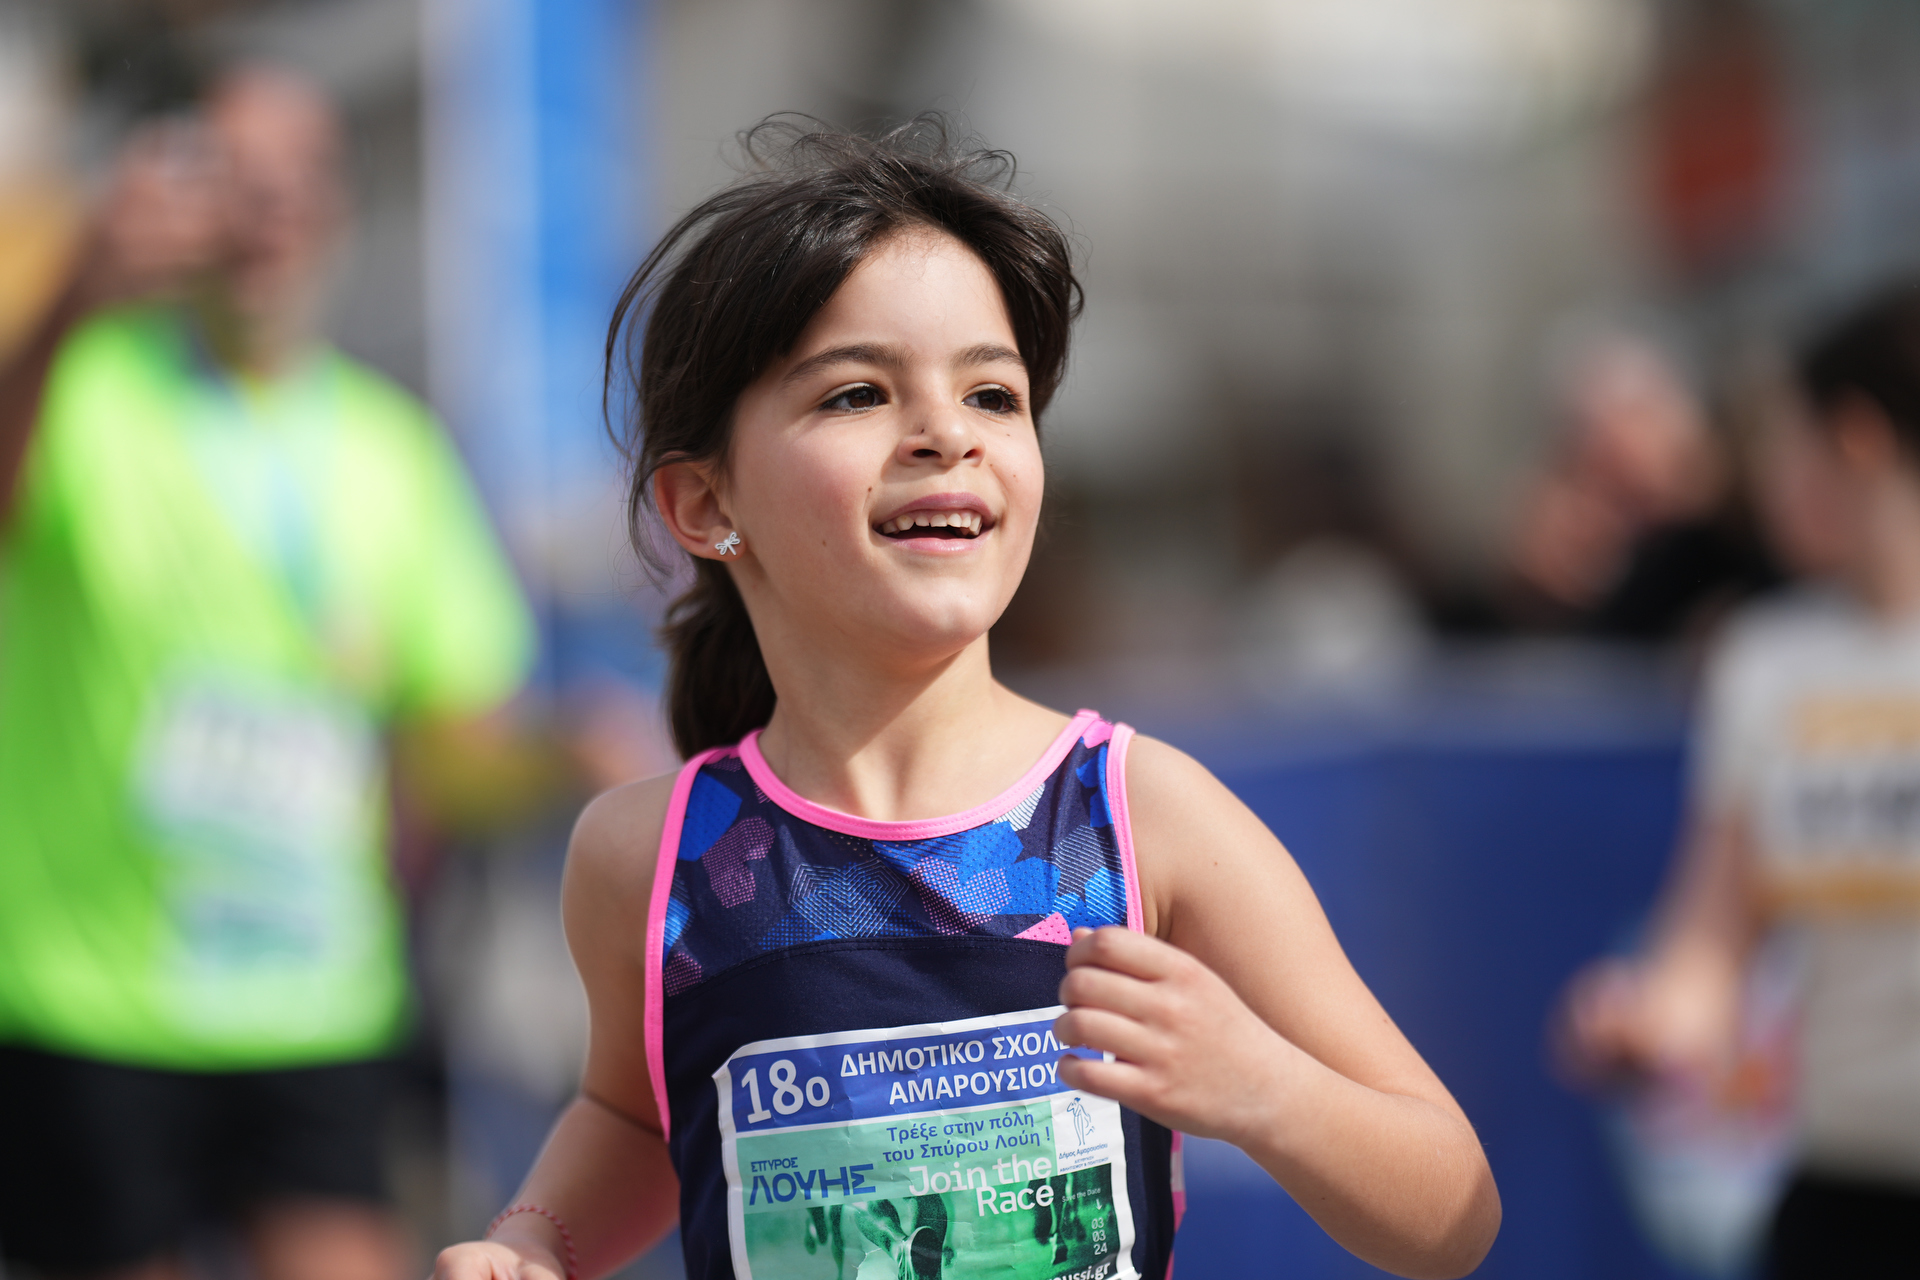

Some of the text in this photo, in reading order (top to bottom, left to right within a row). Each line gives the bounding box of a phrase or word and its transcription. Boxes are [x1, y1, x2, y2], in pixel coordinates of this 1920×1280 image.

[840, 1040, 985, 1077] ΔΗΜΟΤΙΚΟ
[992, 1029, 1070, 1060] ΣΧΟΛ
[889, 1061, 1059, 1105] ΑΜΑΡΟΥΣΙΟΥ
[886, 1111, 1035, 1144] Τρέξε στην πόλη
[882, 1148, 915, 1163] του
[920, 1139, 989, 1159] Σπύρου
[995, 1129, 1041, 1150] Λούη
[751, 1157, 798, 1172] ΣΠΥΡΟΣ
[909, 1153, 1053, 1196] Join the
[749, 1163, 876, 1206] ΛΟΥΗΣ
[976, 1184, 1054, 1217] Race
[1061, 1187, 1102, 1203] Save the Date
[1091, 1217, 1105, 1230] 03
[1092, 1229, 1107, 1242] 03
[1093, 1242, 1108, 1255] 24
